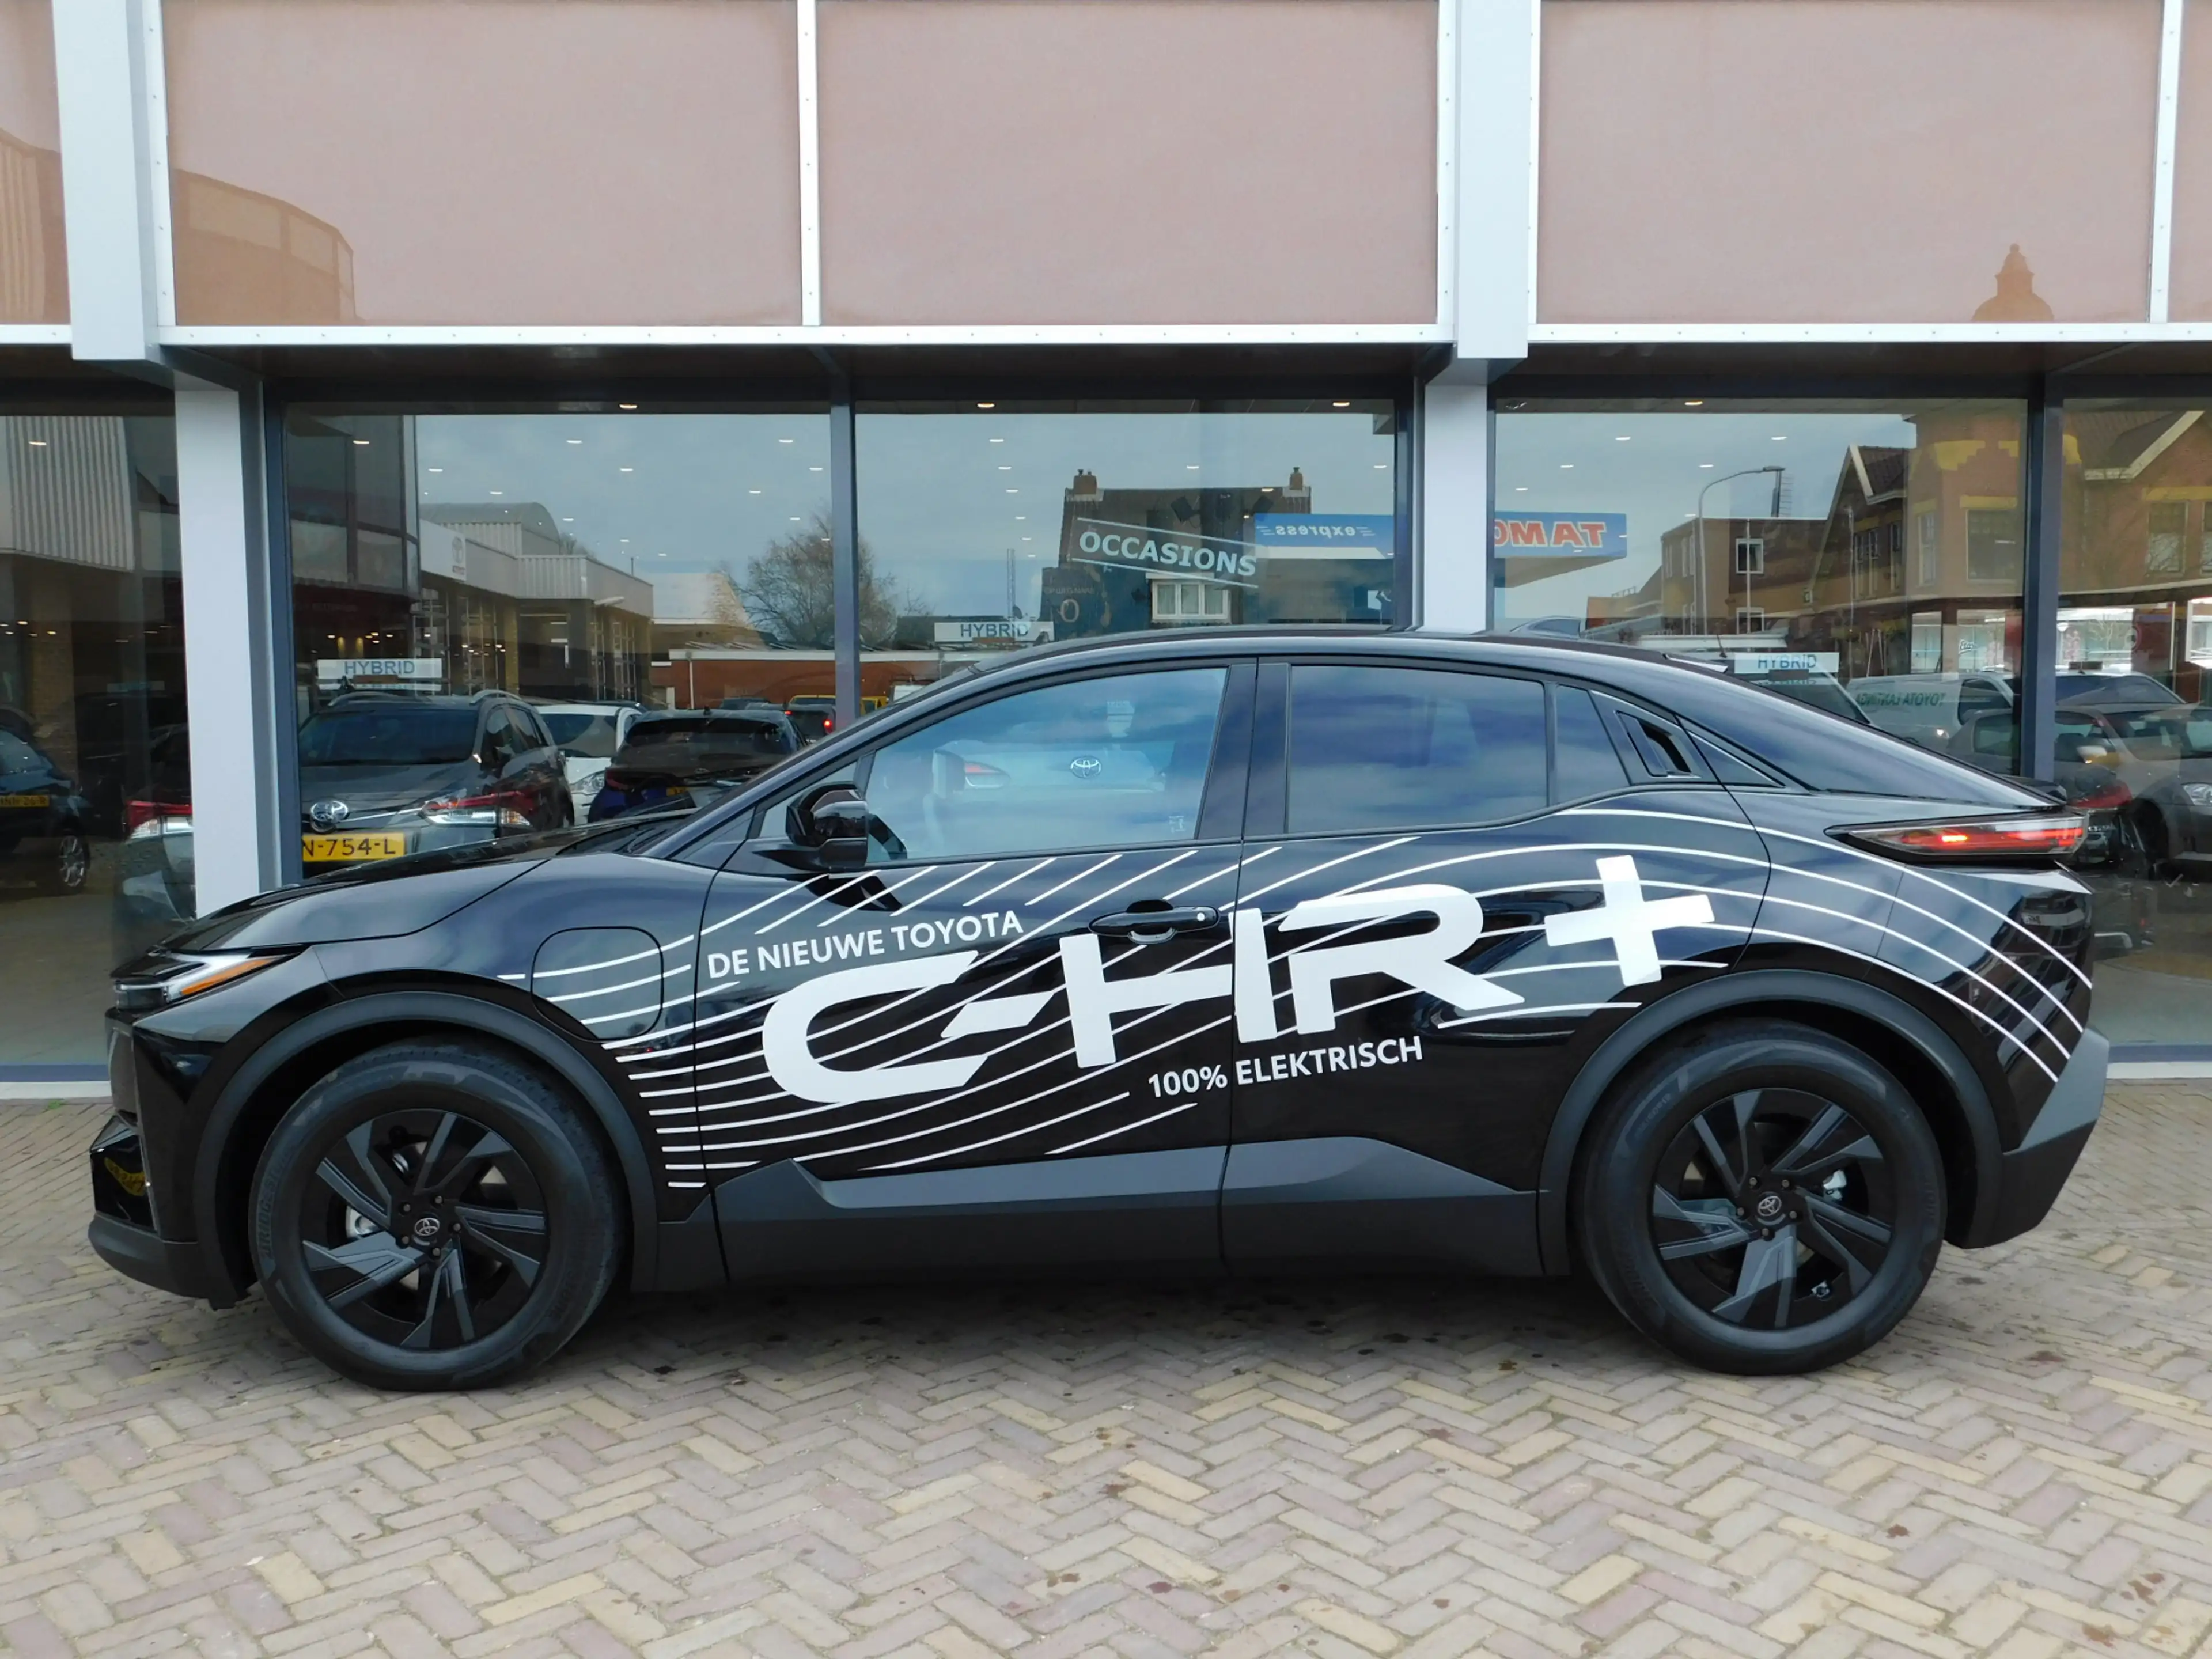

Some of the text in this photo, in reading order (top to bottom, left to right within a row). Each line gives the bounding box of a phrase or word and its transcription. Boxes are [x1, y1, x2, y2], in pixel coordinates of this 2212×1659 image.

[1079, 531, 1257, 576] OCCASIONS
[960, 623, 1029, 638] HYBRID
[345, 660, 415, 675] HYBRID
[1758, 654, 1817, 669] HYBRID
[707, 910, 1024, 979] DE NIEUWE TOYOTA
[1147, 1035, 1424, 1099] 100% ELEKTRISCH
